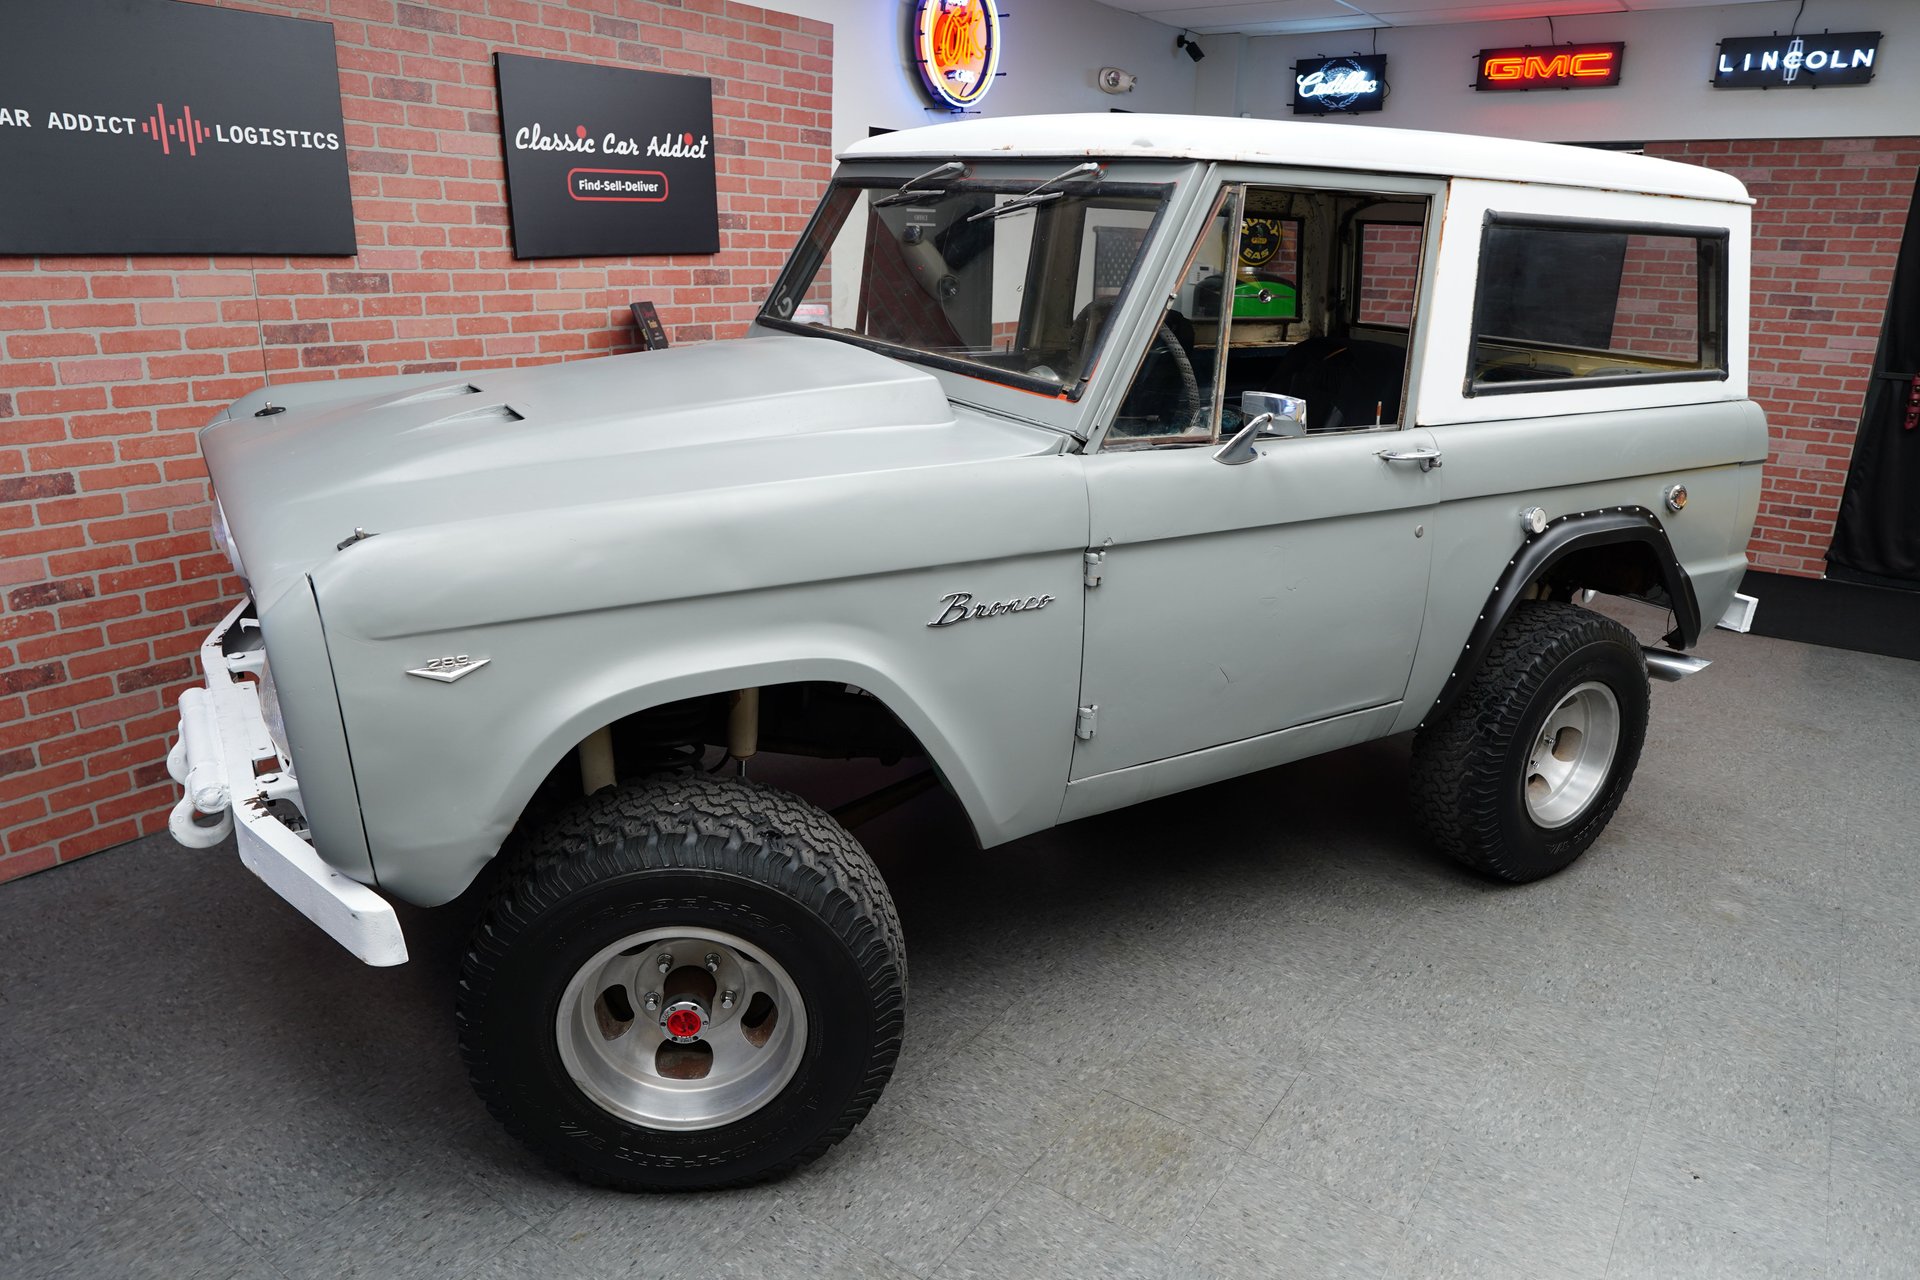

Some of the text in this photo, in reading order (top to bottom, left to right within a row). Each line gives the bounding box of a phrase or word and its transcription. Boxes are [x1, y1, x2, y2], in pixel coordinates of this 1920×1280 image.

[1484, 52, 1612, 80] GMC
[1718, 48, 1875, 72] LINCOLN
[48, 112, 136, 135] ADDICT
[215, 124, 340, 150] LOGISTICS
[515, 122, 709, 159] Classic Car Addict
[578, 179, 659, 192] Find-Sell-Deliver
[1243, 247, 1270, 259] GAS
[926, 591, 1056, 627] Bronco
[426, 654, 469, 670] 289
